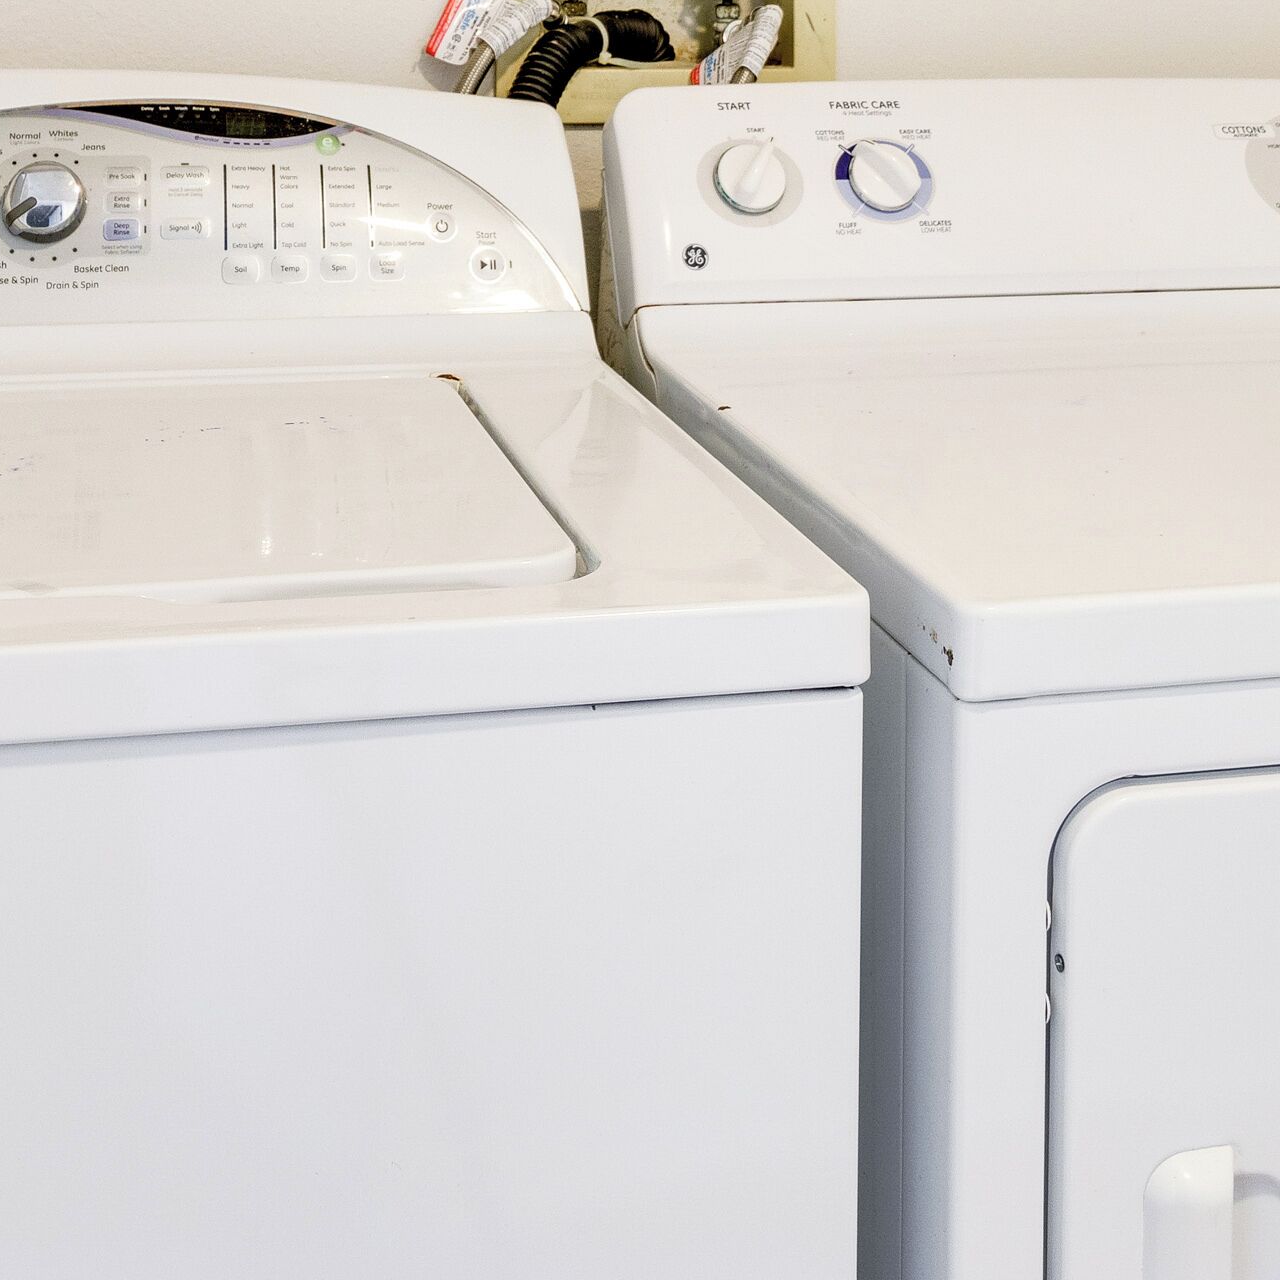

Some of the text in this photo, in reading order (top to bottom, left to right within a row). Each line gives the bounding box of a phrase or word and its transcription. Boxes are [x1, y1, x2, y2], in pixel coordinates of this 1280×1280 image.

[717, 102, 751, 111] START
[829, 100, 901, 110] FABRIC CARE
[866, 110, 892, 118] Settings
[1221, 126, 1267, 135] COTTONS
[9, 132, 41, 140] Normal
[81, 143, 106, 151] Jeans
[427, 202, 453, 210] Power
[476, 231, 497, 239] Start
[74, 264, 130, 273] Basket Clean
[20, 276, 39, 285] Spin
[46, 281, 99, 290] Drain & Spin
